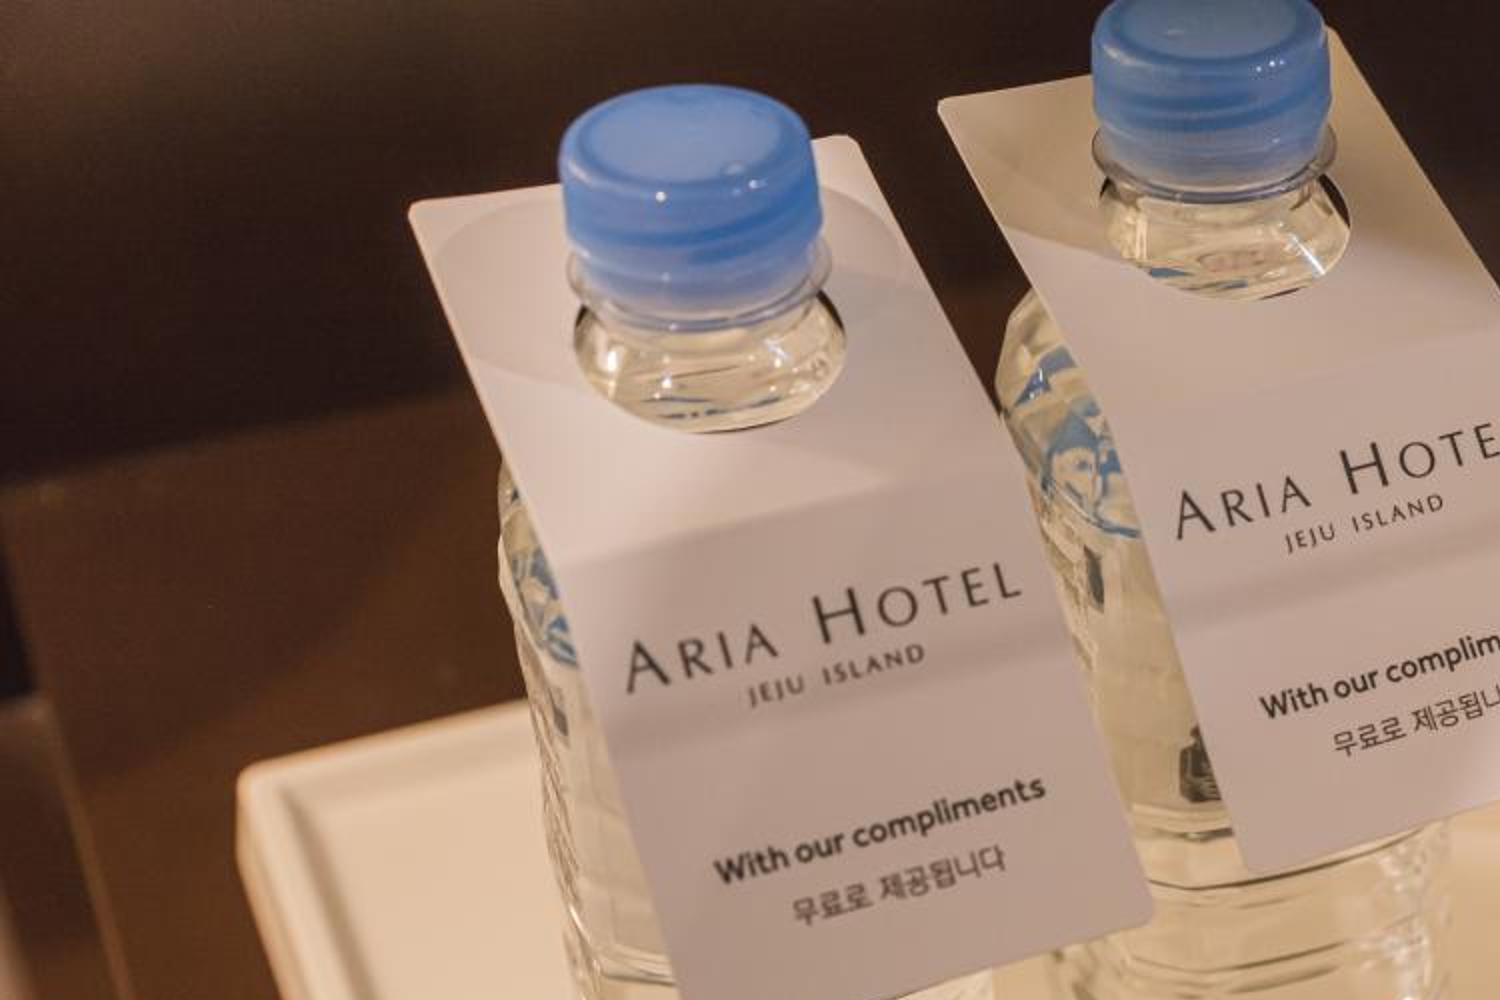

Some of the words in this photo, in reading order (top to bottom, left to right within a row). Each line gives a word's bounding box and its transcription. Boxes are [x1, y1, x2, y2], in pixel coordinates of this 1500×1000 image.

[1175, 475, 1312, 541] ARIA
[1285, 522, 1337, 554] JEJU
[1351, 494, 1445, 534] ISLAND
[624, 624, 779, 695] ARIA
[811, 562, 1023, 645] HOTEL
[747, 675, 805, 708] JEJU
[822, 643, 926, 686] ISLAND
[1258, 677, 1330, 721] With
[1333, 669, 1379, 699] our
[1333, 716, 1407, 757] 무료로
[713, 844, 791, 886] With
[794, 833, 845, 865] our
[852, 777, 1046, 849] compliments
[792, 882, 875, 926] 무료로
[879, 844, 1006, 899] 제공됩니다
